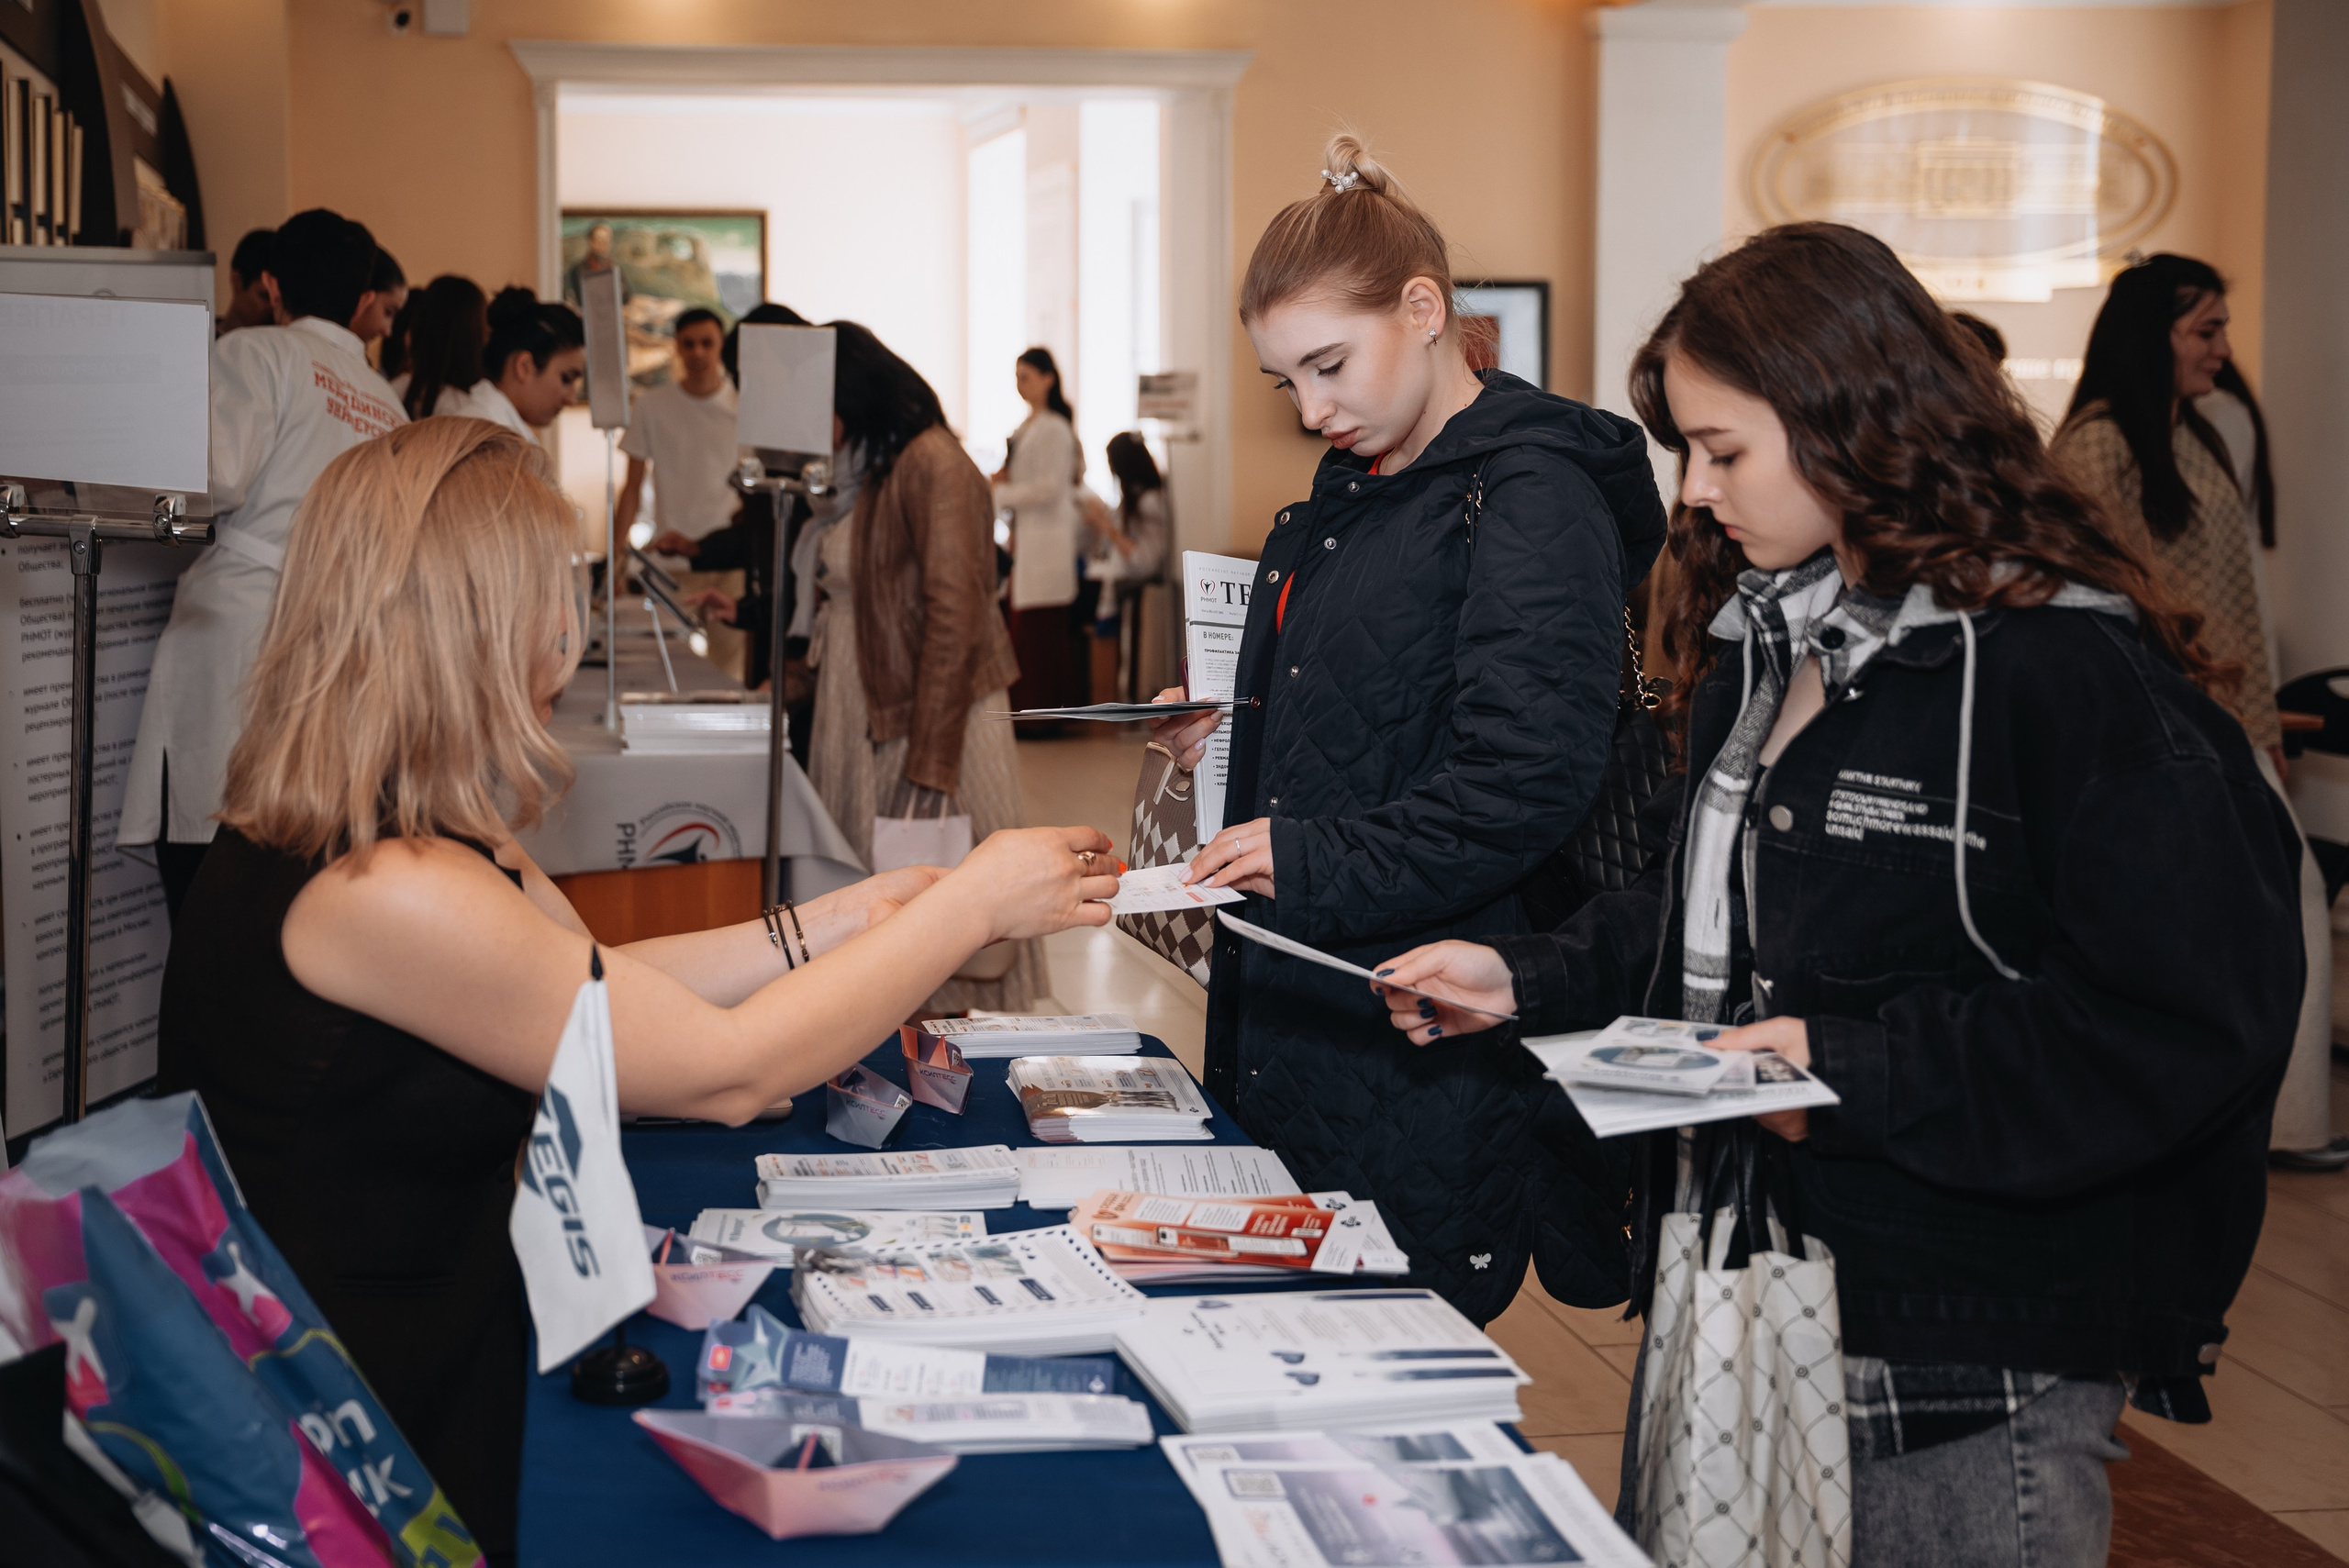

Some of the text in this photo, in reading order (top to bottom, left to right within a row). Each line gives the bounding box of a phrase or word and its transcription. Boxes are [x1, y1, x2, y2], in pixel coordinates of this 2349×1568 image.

[1219, 581, 1252, 606] ТЕ
[1208, 632, 1234, 641] НОМЕРЕ:
[1825, 822, 1865, 841] unsaid
[532, 1132, 602, 1280] EGIS
